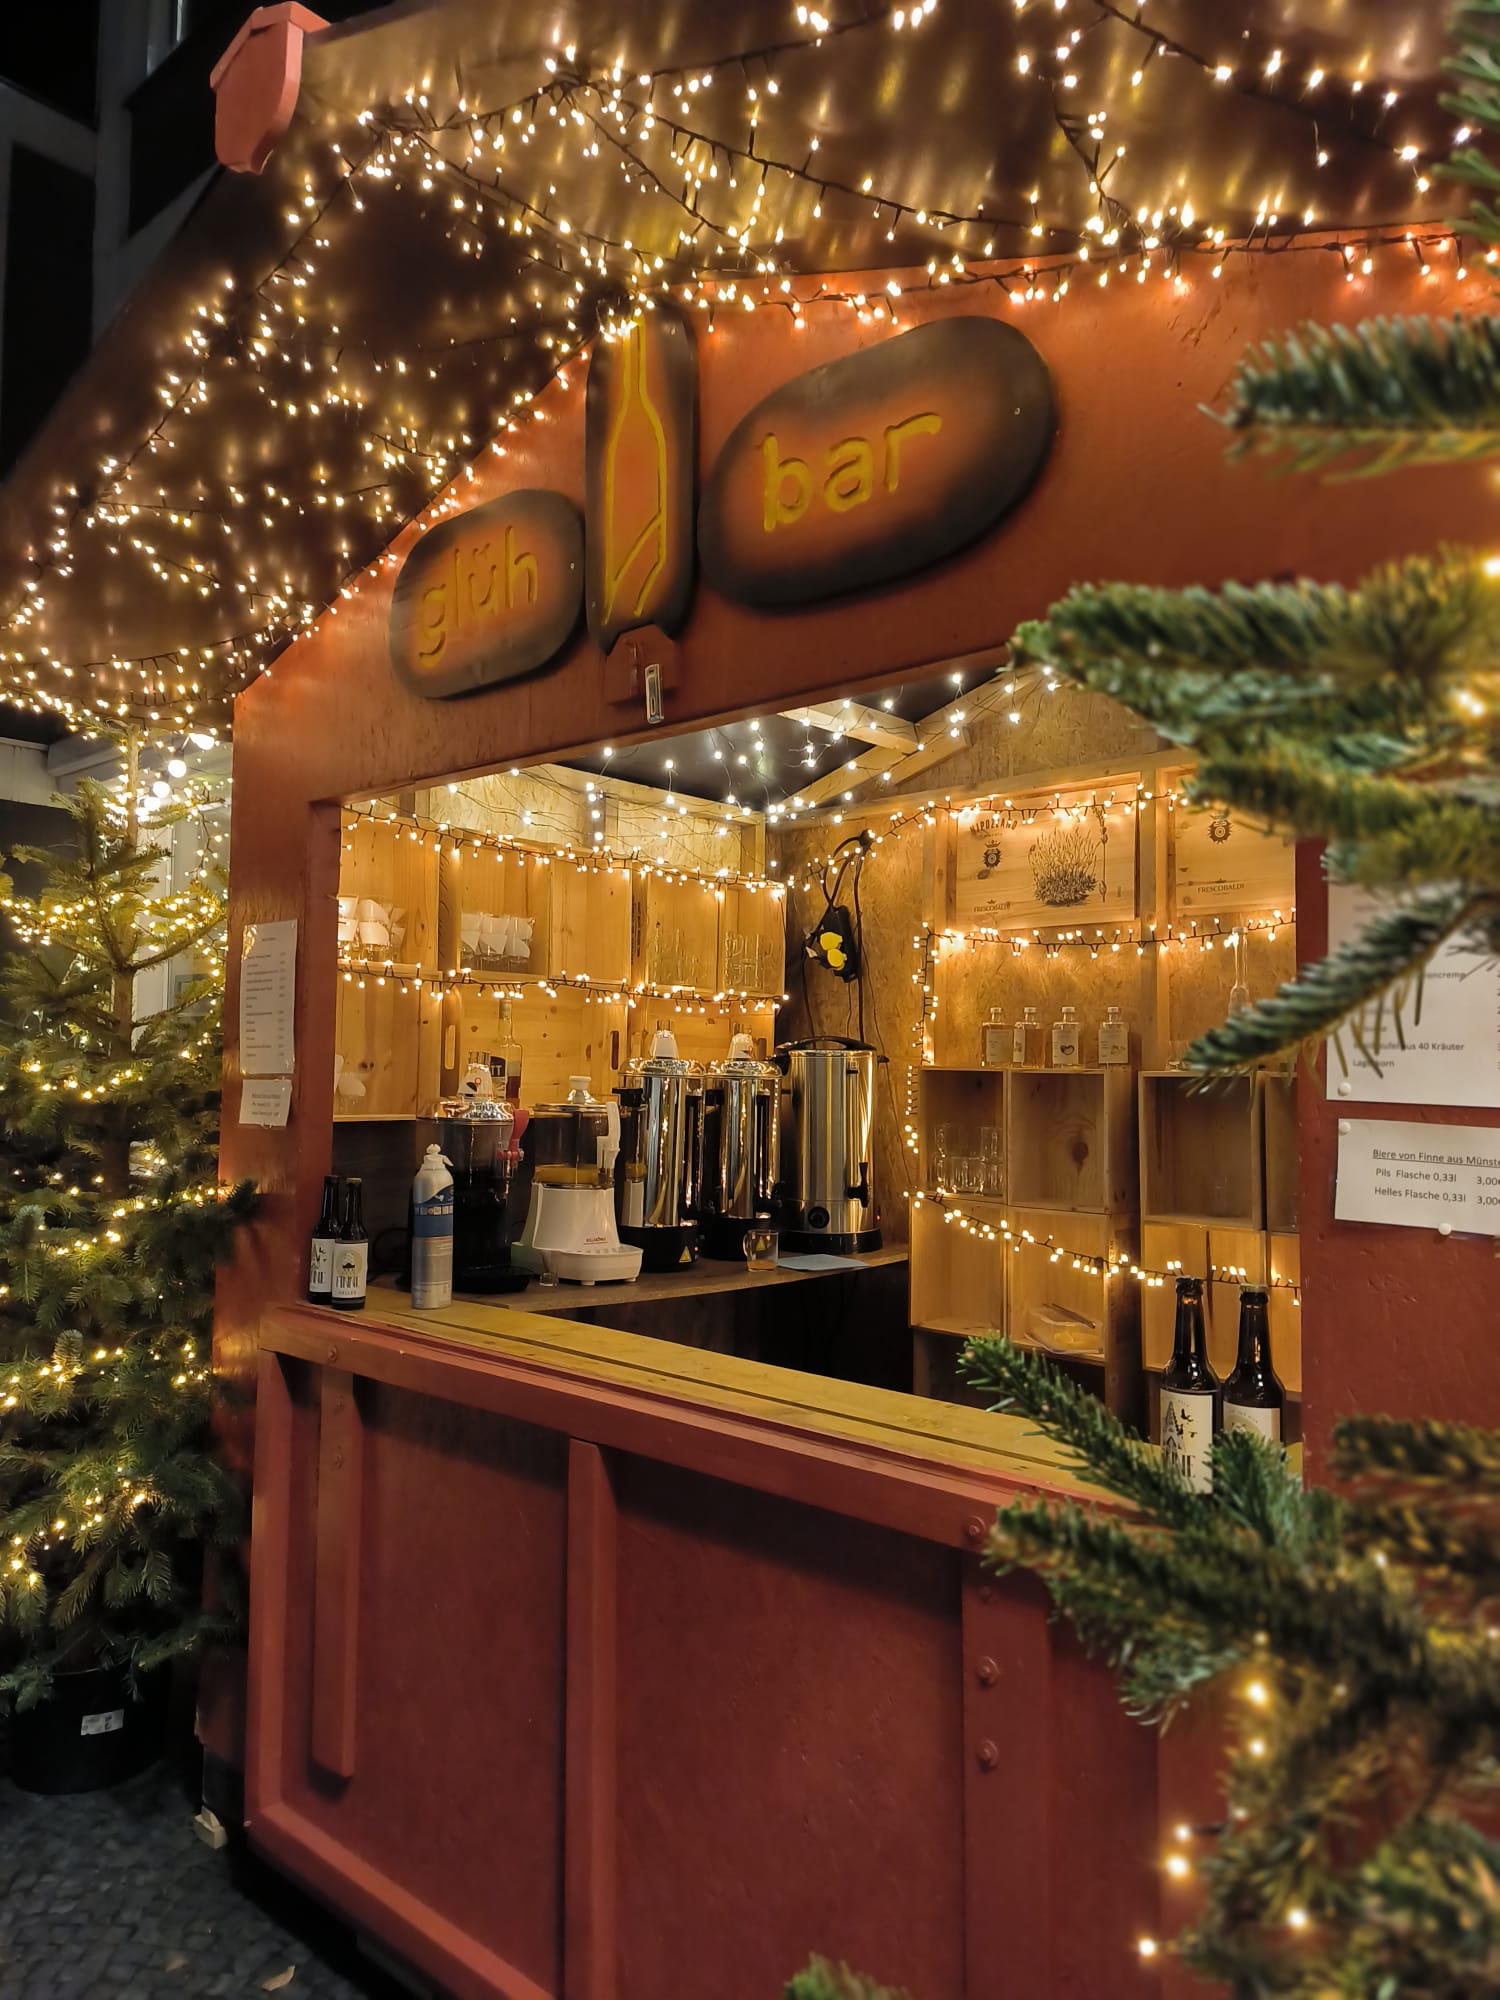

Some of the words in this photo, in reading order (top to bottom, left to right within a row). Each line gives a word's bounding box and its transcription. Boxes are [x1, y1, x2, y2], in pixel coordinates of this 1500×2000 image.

[416, 526, 537, 667] glüh
[761, 412, 942, 532] bar
[1198, 883, 1245, 894] FRESCOBALDI
[1418, 1042, 1430, 1051] 40
[1431, 1041, 1465, 1052] Kräuter
[1353, 1058, 1395, 1069] Lagorn
[1373, 1149, 1397, 1160] Biere
[1399, 1153, 1416, 1161] von
[1418, 1151, 1445, 1163] Finne
[1447, 1156, 1464, 1165] aus
[1375, 1168, 1391, 1178] Pils
[1396, 1169, 1431, 1181] Flasche
[1432, 1172, 1457, 1183] 0,33l
[1374, 1186, 1403, 1198] Helles
[1405, 1188, 1440, 1201] Flasche
[1442, 1192, 1466, 1204] 0,33l
